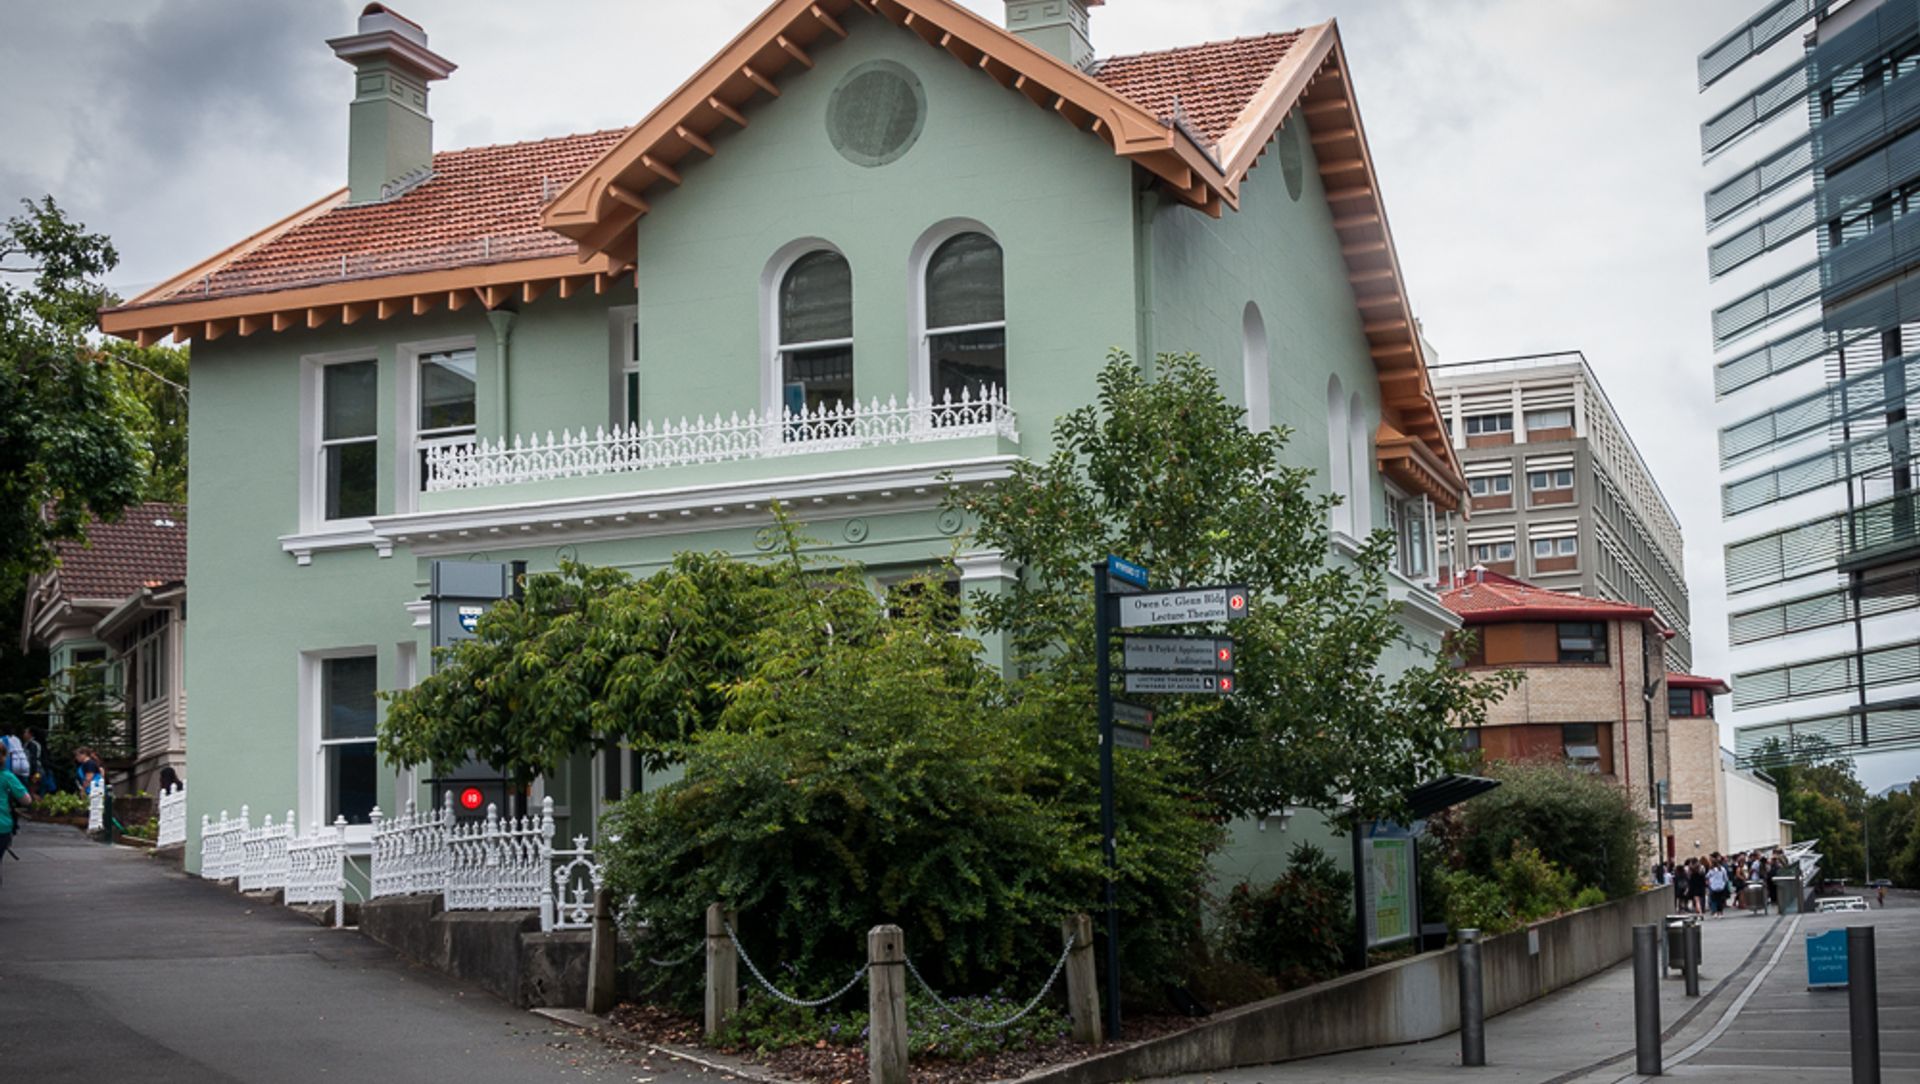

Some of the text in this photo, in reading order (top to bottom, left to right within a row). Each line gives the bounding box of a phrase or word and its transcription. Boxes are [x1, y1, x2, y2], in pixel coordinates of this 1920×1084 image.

[1135, 594, 1225, 610] Owen G. Glenn Bldg
[1151, 609, 1225, 622] Lecture Theatres
[1174, 656, 1213, 666] Auditorium
